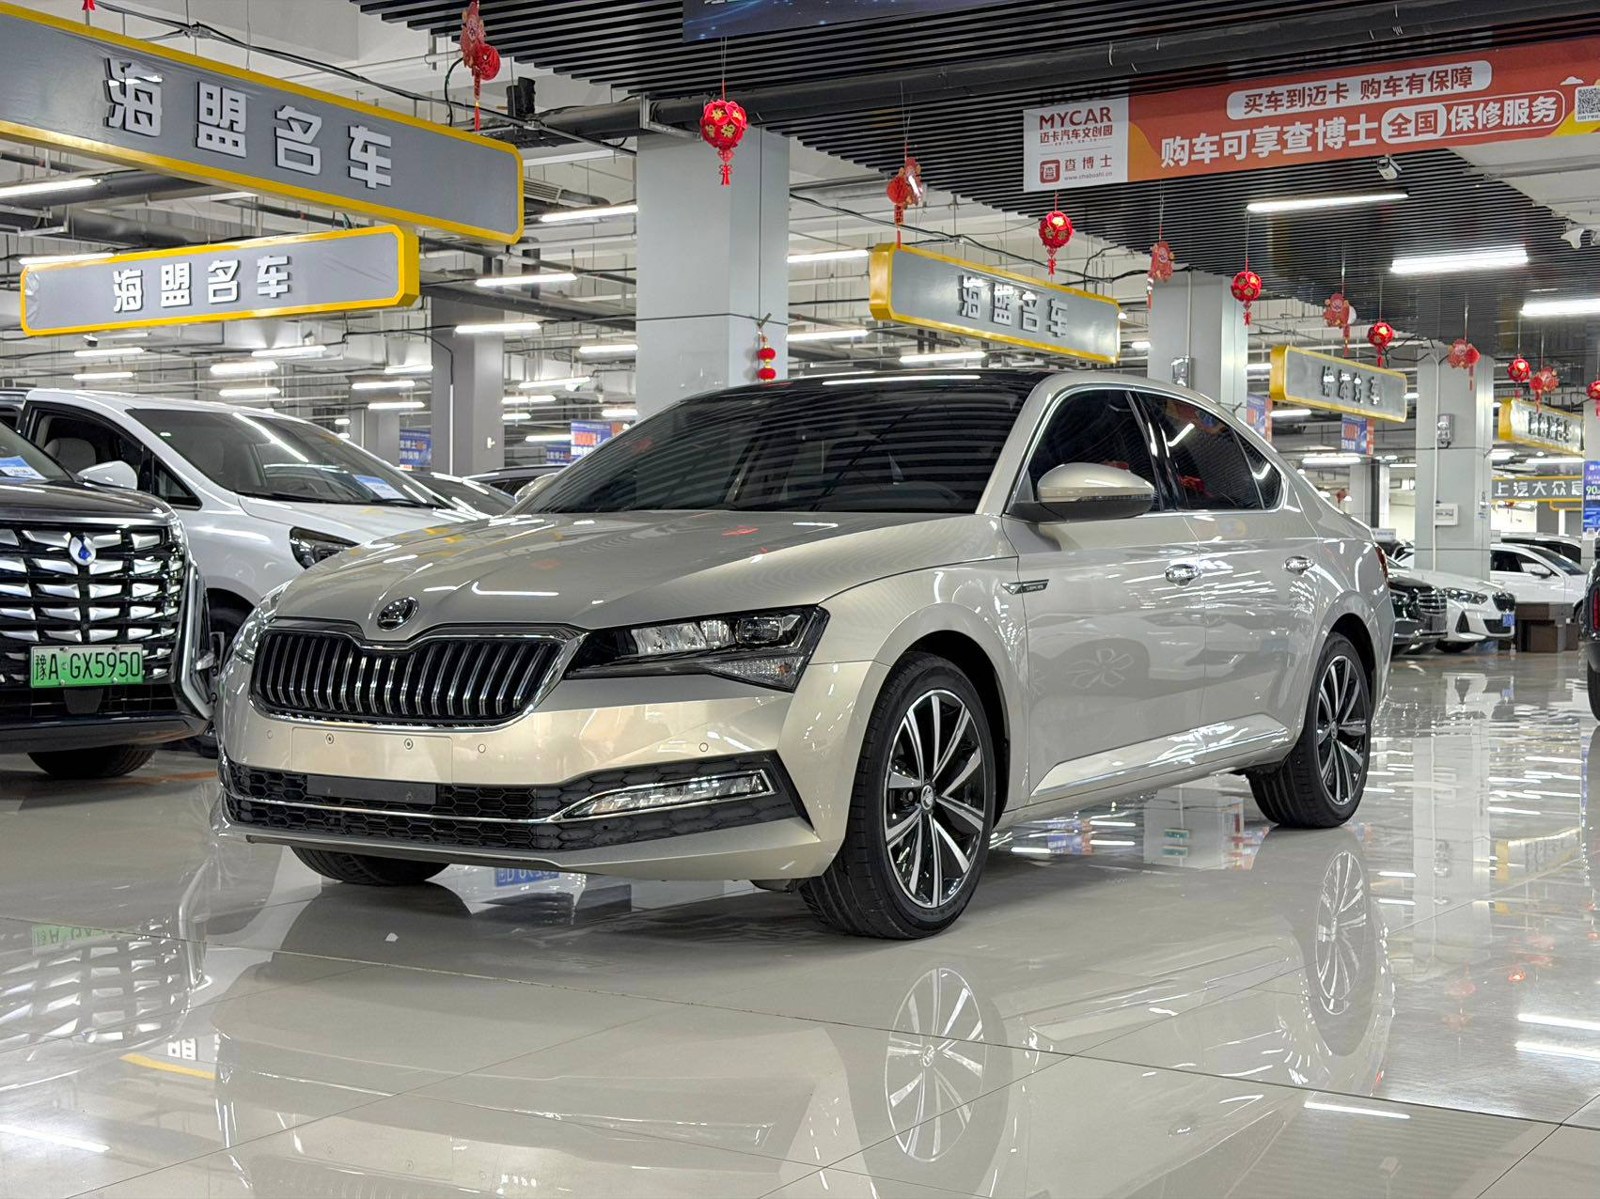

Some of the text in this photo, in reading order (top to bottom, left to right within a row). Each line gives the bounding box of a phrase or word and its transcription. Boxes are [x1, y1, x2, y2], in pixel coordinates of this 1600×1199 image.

[1244, 66, 1473, 115] 买车到迈卡 购车有保障
[104, 57, 391, 188] 海盟名车
[1039, 106, 1112, 130] MYCAR
[1064, 154, 1112, 172] 查博士
[113, 255, 290, 312] 海盟名车
